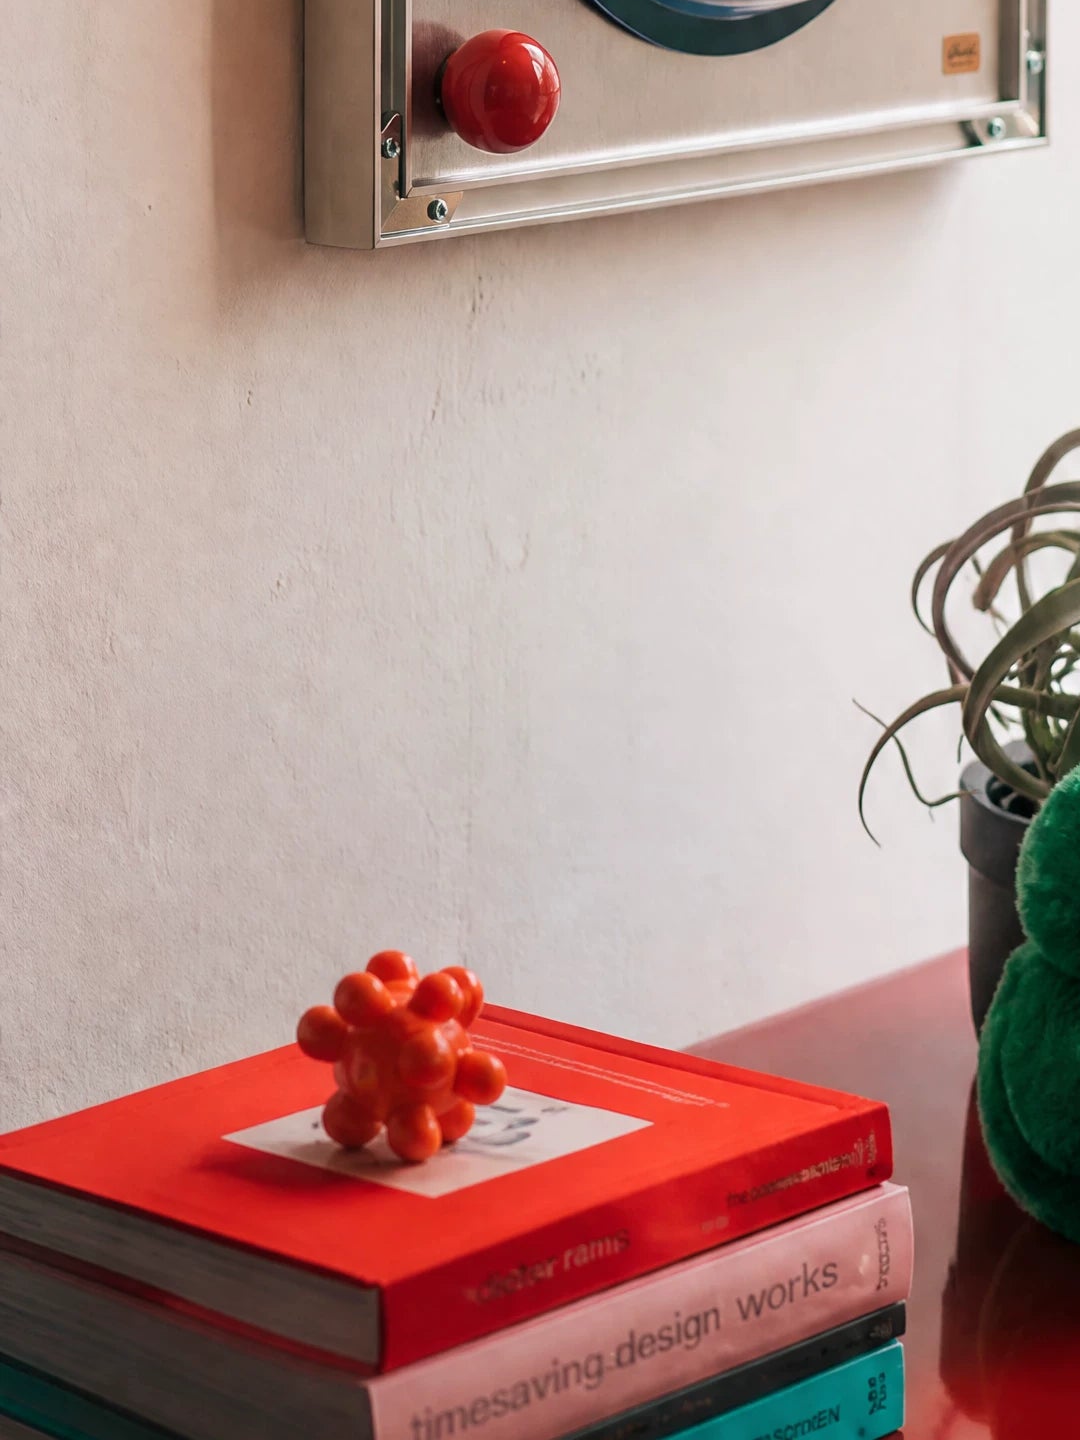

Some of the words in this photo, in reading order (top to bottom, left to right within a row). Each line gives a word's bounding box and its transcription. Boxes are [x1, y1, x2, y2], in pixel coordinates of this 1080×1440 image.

[562, 1229, 632, 1271] rams
[410, 1352, 605, 1440] timesaving
[614, 1305, 720, 1368] design
[736, 1261, 838, 1322] works
